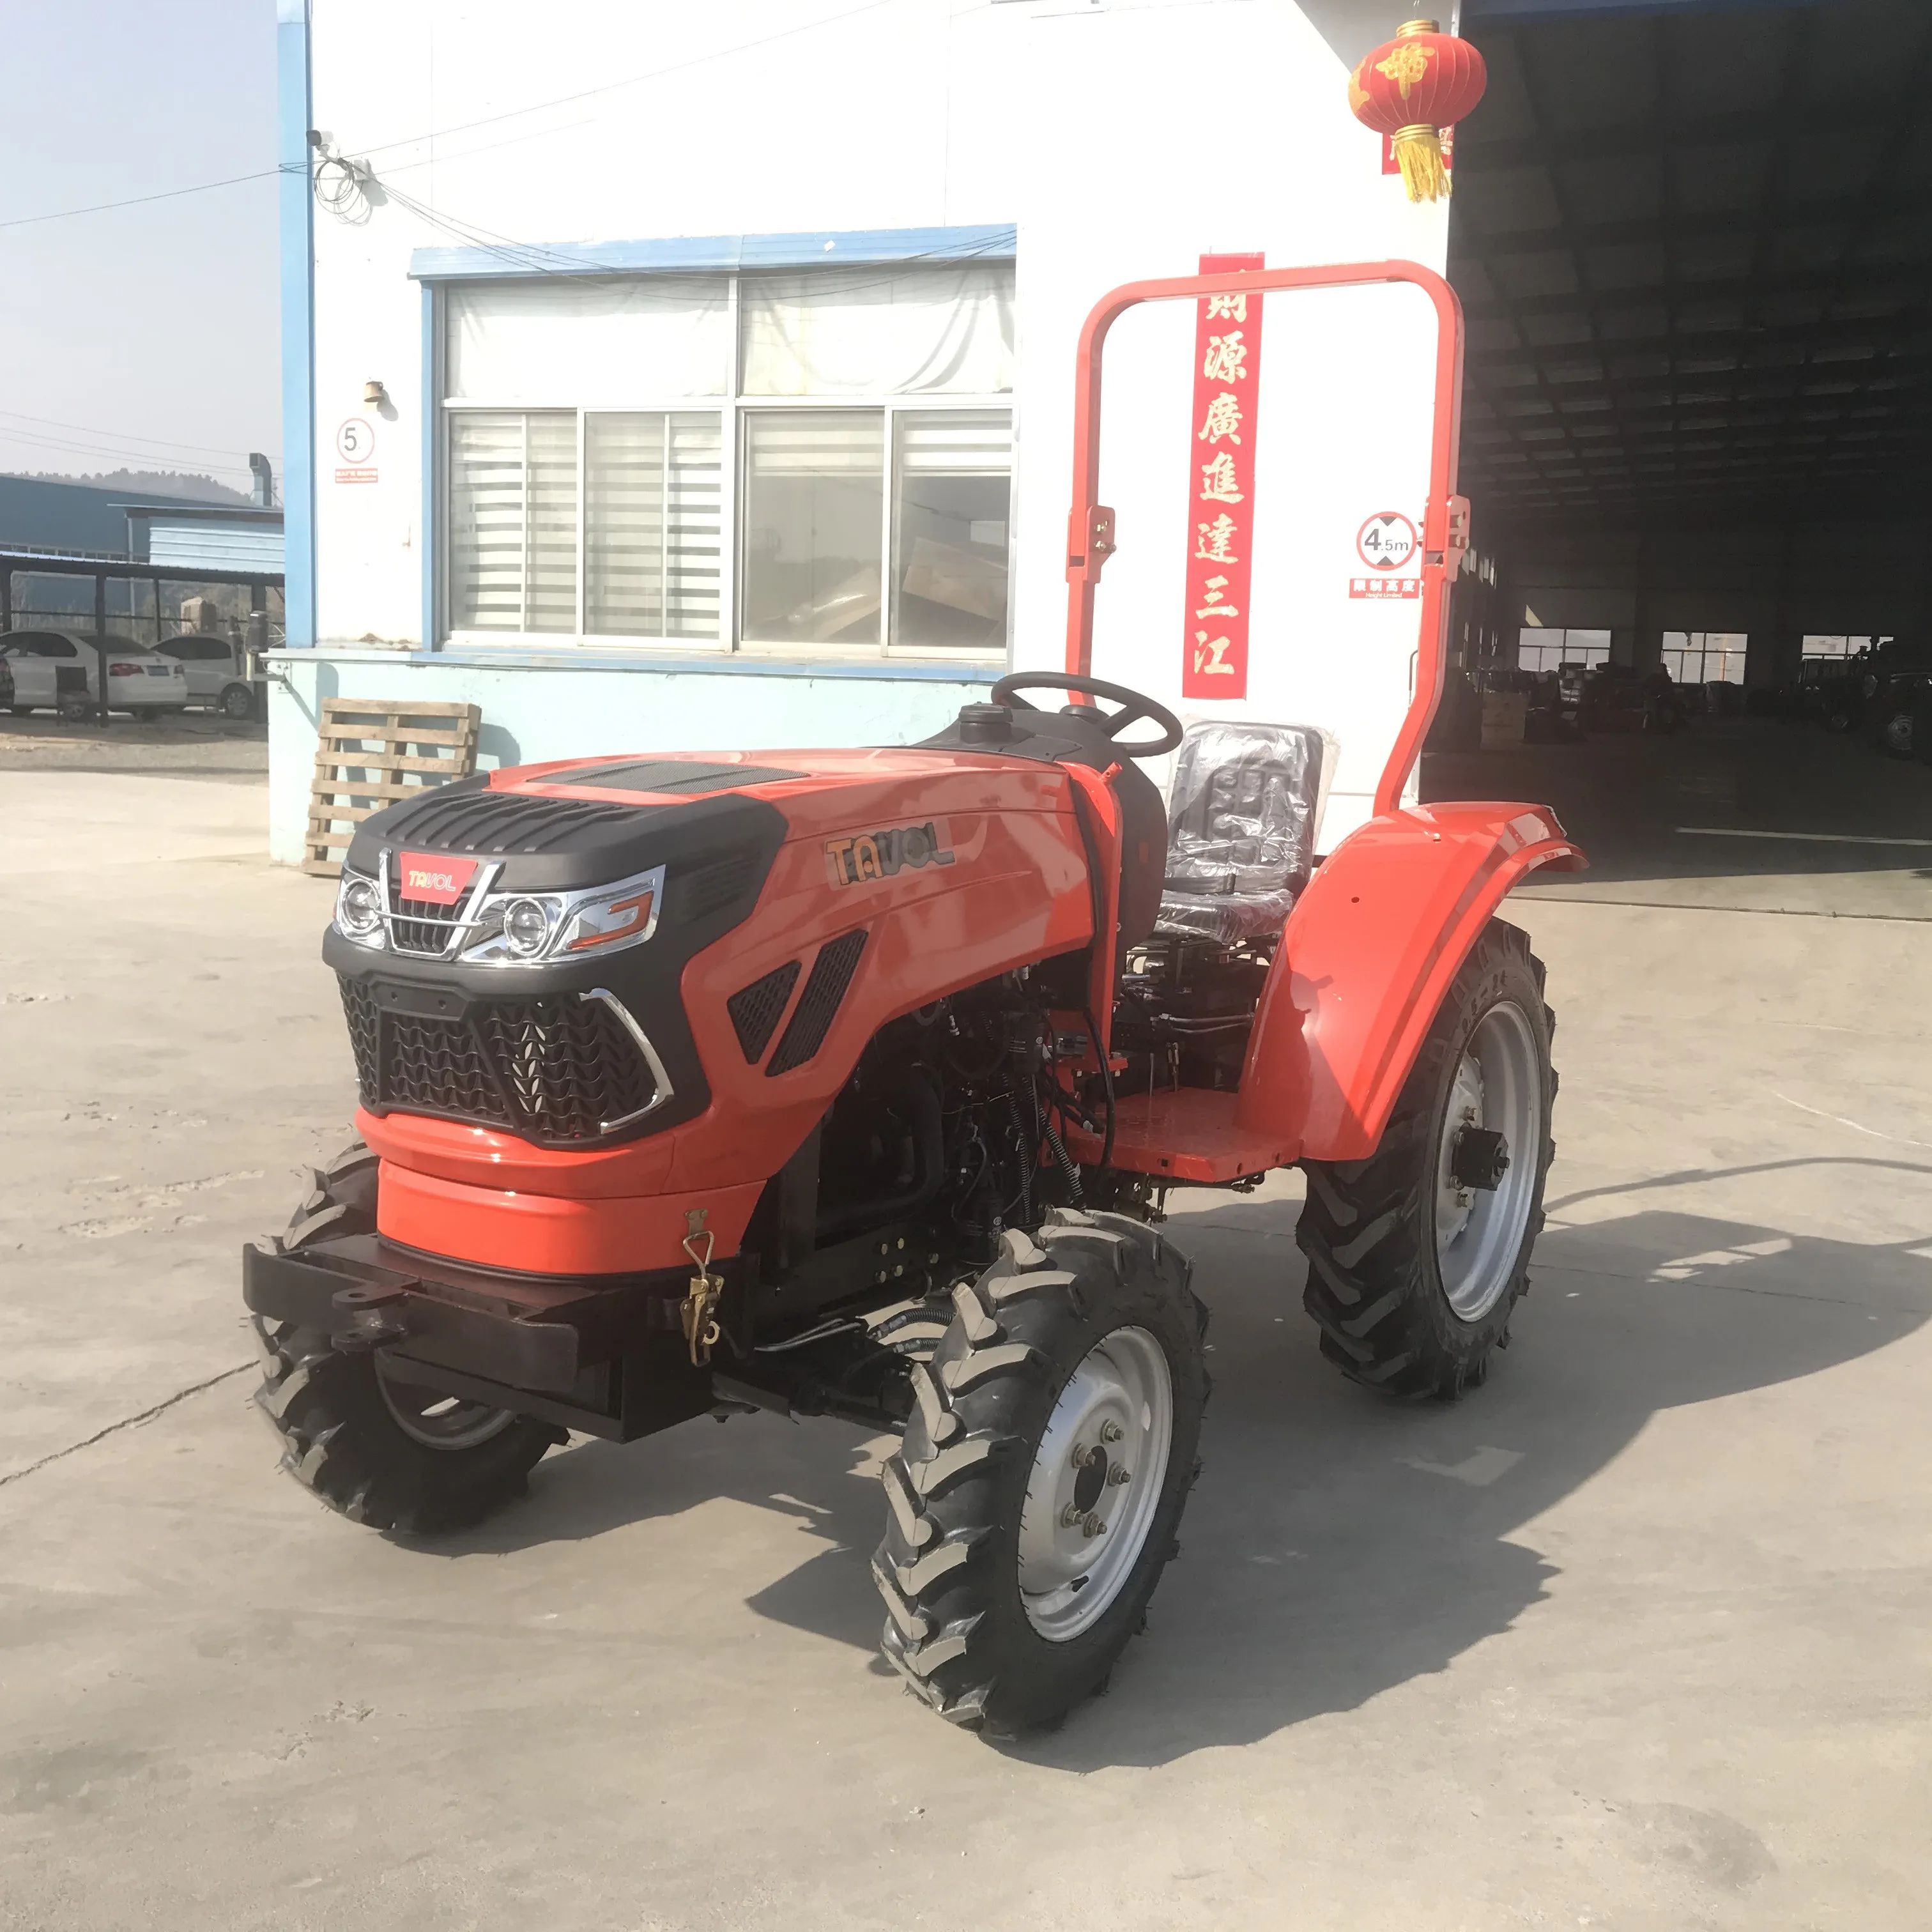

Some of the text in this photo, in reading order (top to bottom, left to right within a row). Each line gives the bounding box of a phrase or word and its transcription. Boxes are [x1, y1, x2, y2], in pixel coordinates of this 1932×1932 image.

[344, 427, 357, 452] 5
[1364, 528, 1409, 551] 4.5m
[826, 822, 956, 885] TAVOL
[409, 870, 456, 892] TAVOL
